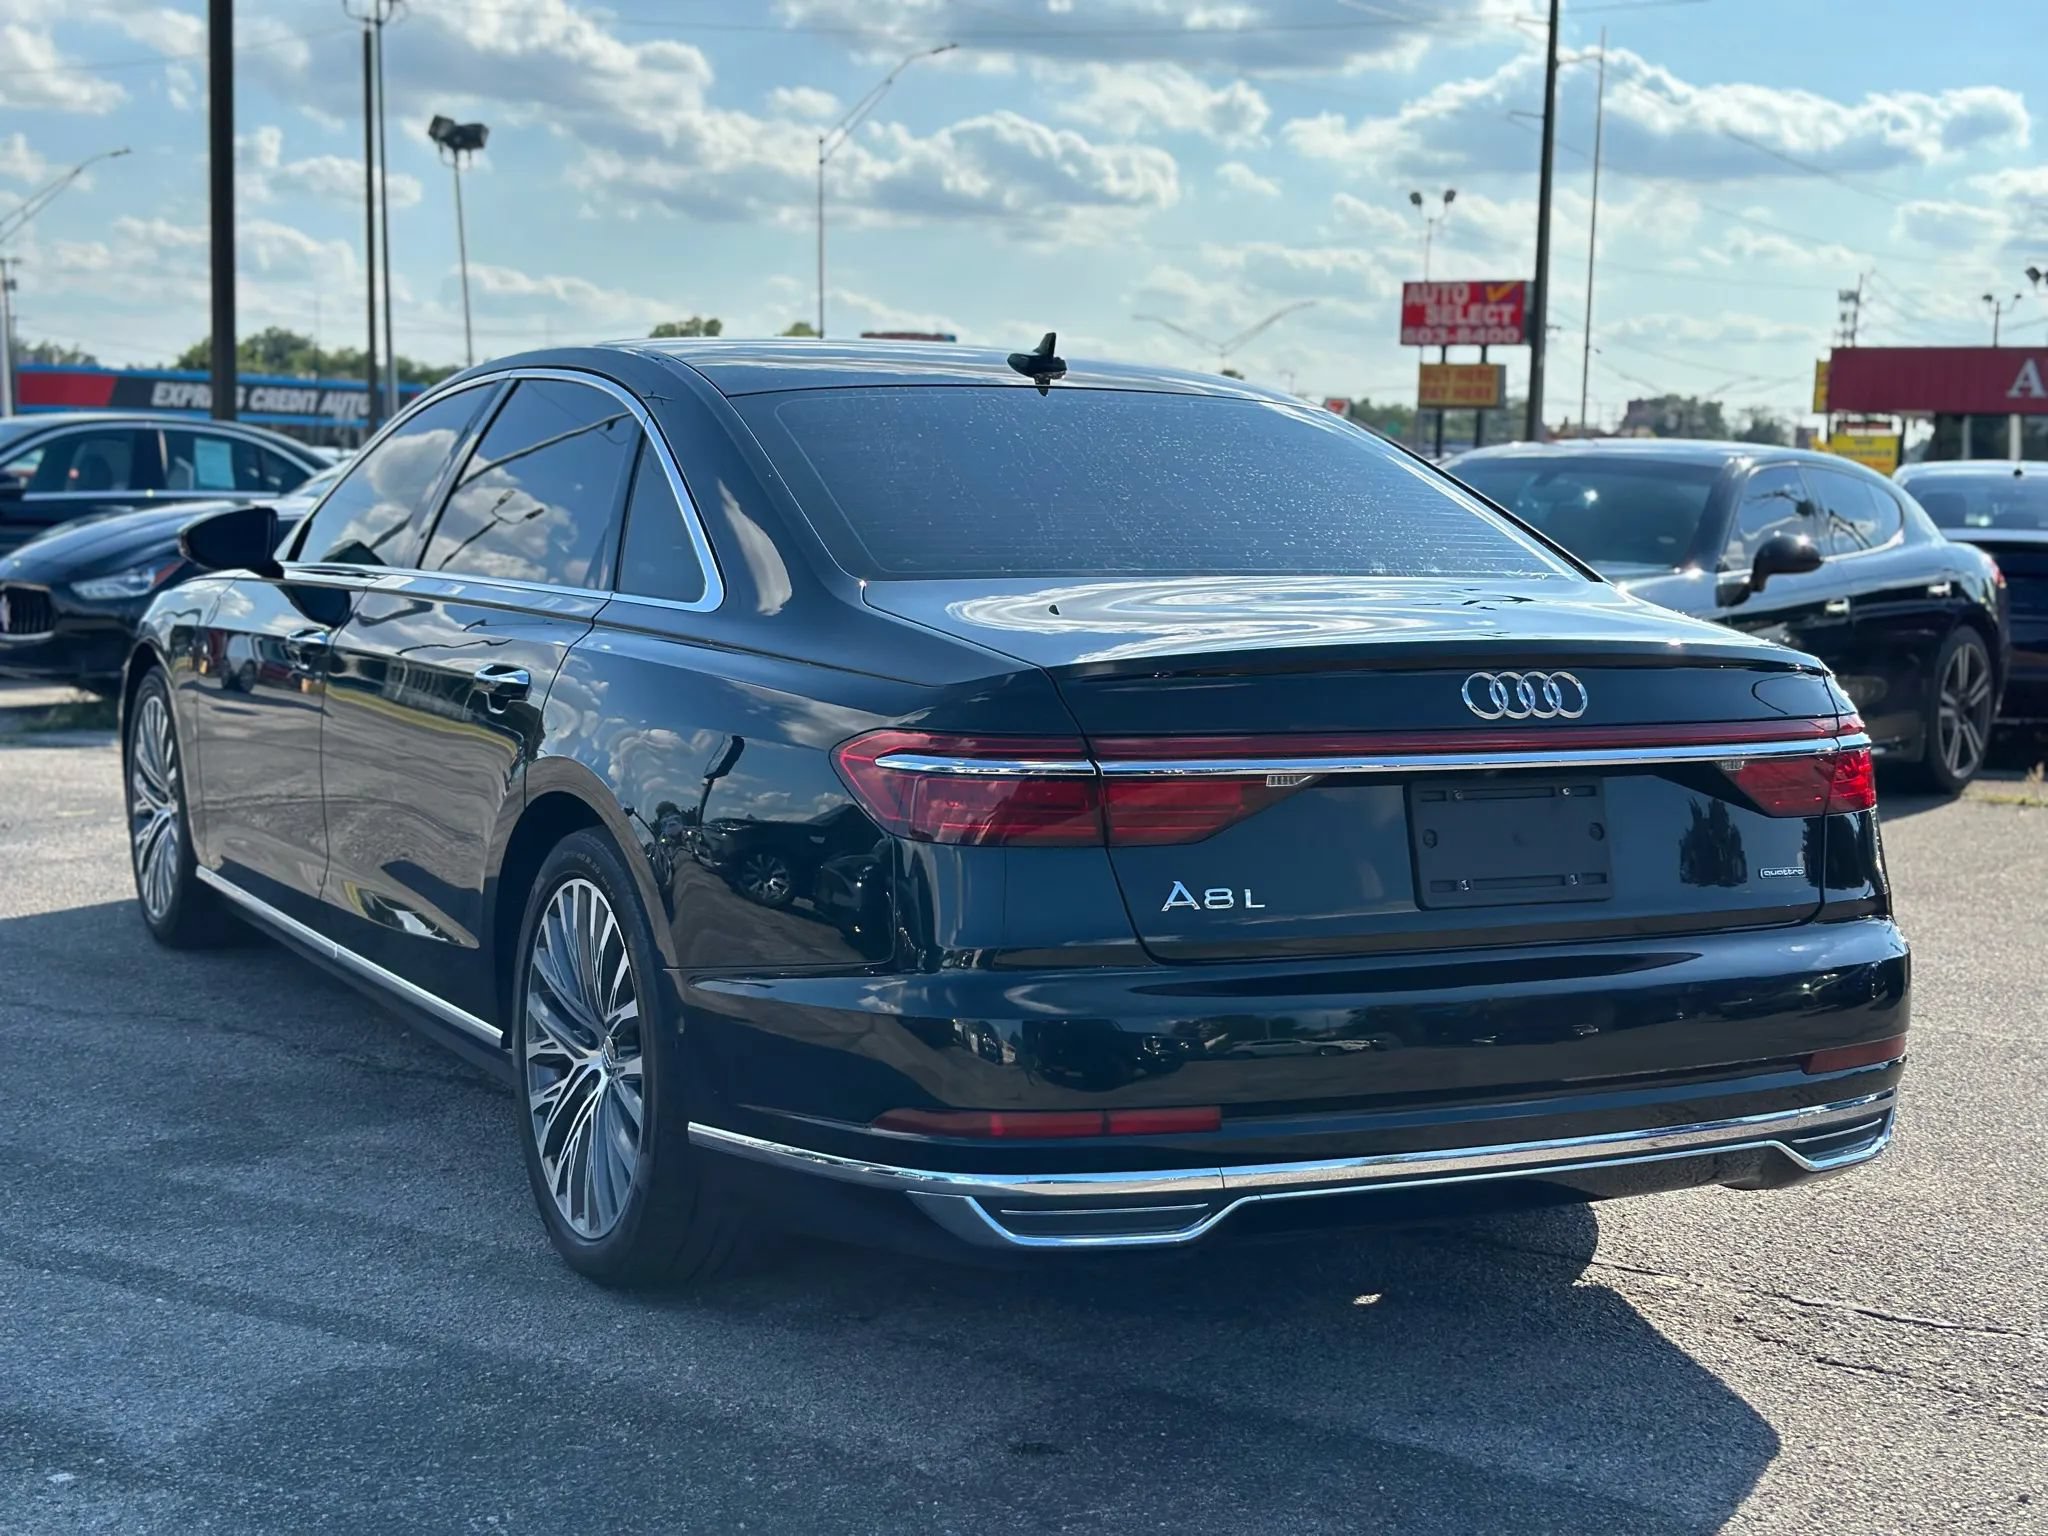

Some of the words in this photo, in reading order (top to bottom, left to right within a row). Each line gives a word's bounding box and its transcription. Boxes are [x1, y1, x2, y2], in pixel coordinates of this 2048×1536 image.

[1405, 283, 1470, 305] AUTO
[1424, 303, 1516, 326] SELECT
[249, 387, 318, 413] CREDIT
[319, 391, 370, 416] AUTO
[1762, 868, 1804, 877] quattro
